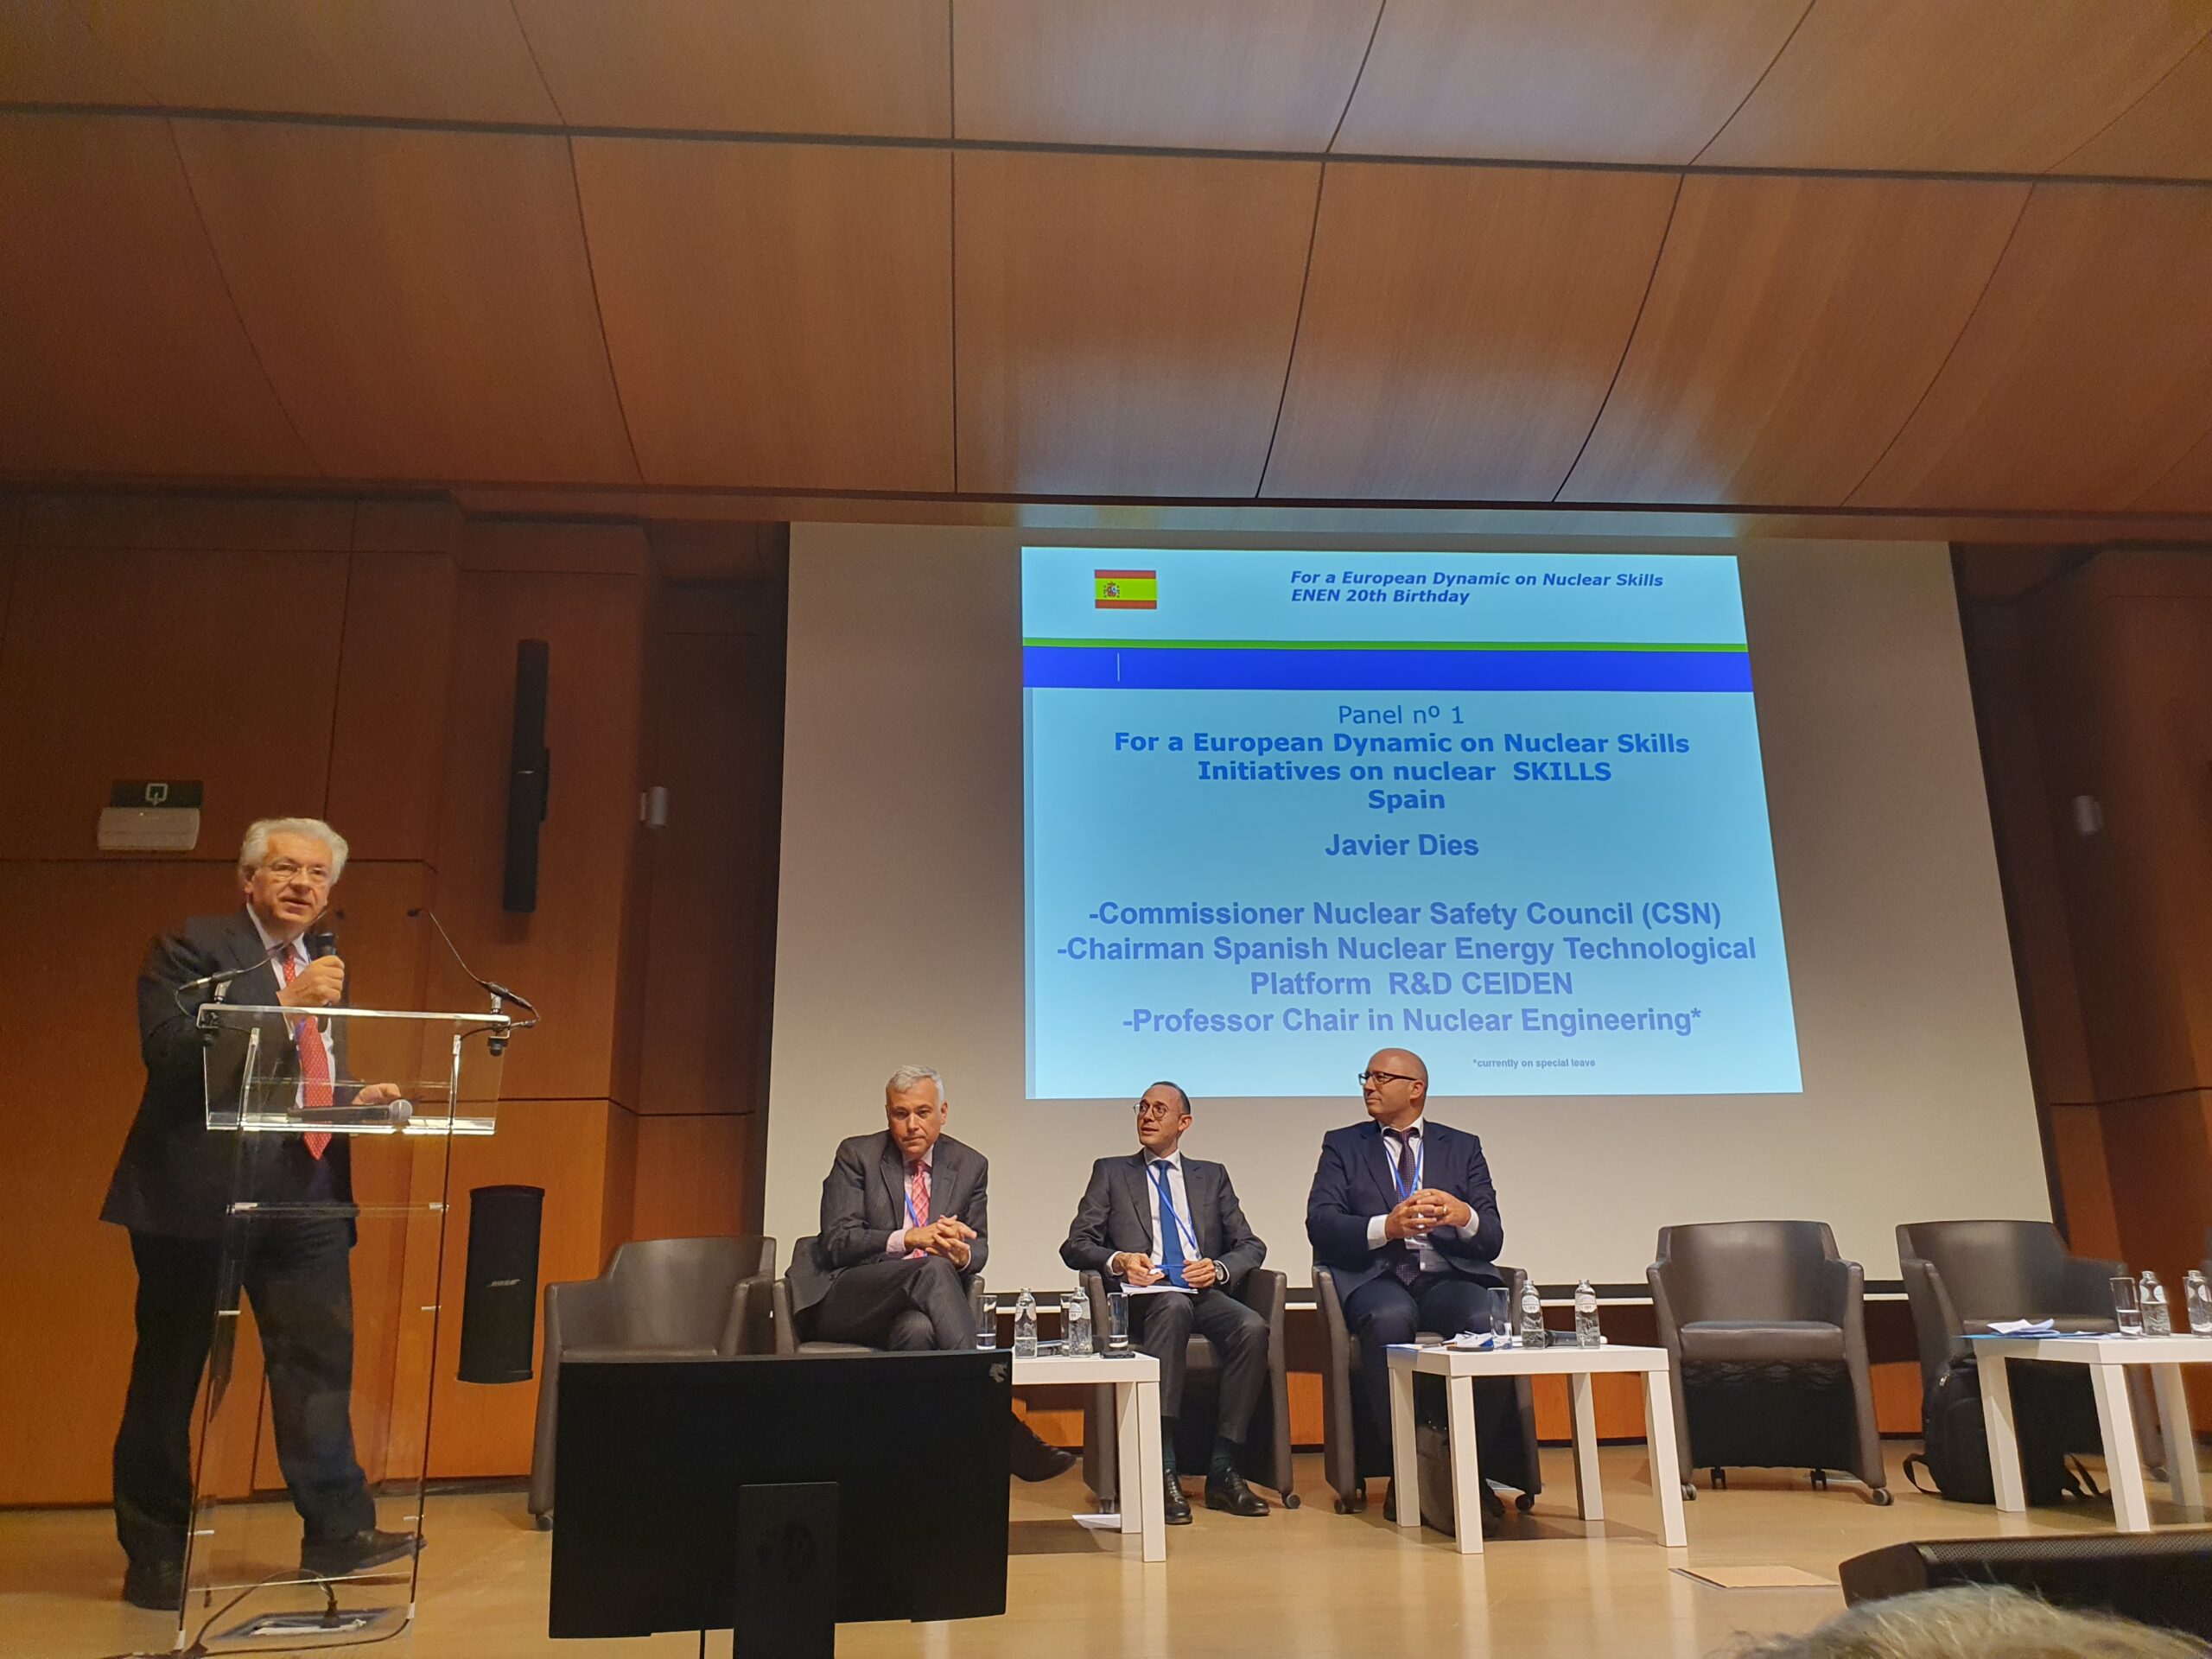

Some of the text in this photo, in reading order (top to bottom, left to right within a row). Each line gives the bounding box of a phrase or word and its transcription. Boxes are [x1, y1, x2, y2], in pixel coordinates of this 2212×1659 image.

[1291, 571, 1662, 587] For a European Dynamic on Nuclear Skills
[1292, 589, 1470, 605] ENEN 20th Birthday
[1339, 705, 1402, 724] Panel
[1452, 706, 1464, 723] 1
[1116, 733, 1689, 756] For a European Dynamic on Nuclear Skills
[1198, 760, 1611, 781] Initiatives on nuclear SKILLS
[1369, 789, 1445, 813] Spain
[1325, 834, 1478, 855] Javier Dies
[1090, 902, 1720, 931] -Commissioner Nuclear Safety Council (CSN)
[1058, 937, 1756, 965] -Chairman Spanish Nuclear Energy Technological
[1251, 972, 1573, 995] Platform R&D CEIDEN
[1123, 1008, 1274, 1032] -Professor
[1283, 1007, 1359, 1031] Chair
[1369, 1008, 1393, 1031] in
[1403, 1008, 1513, 1031] Nuclear
[1535, 1058, 1569, 1069] special
[1570, 1058, 1596, 1066] leave
